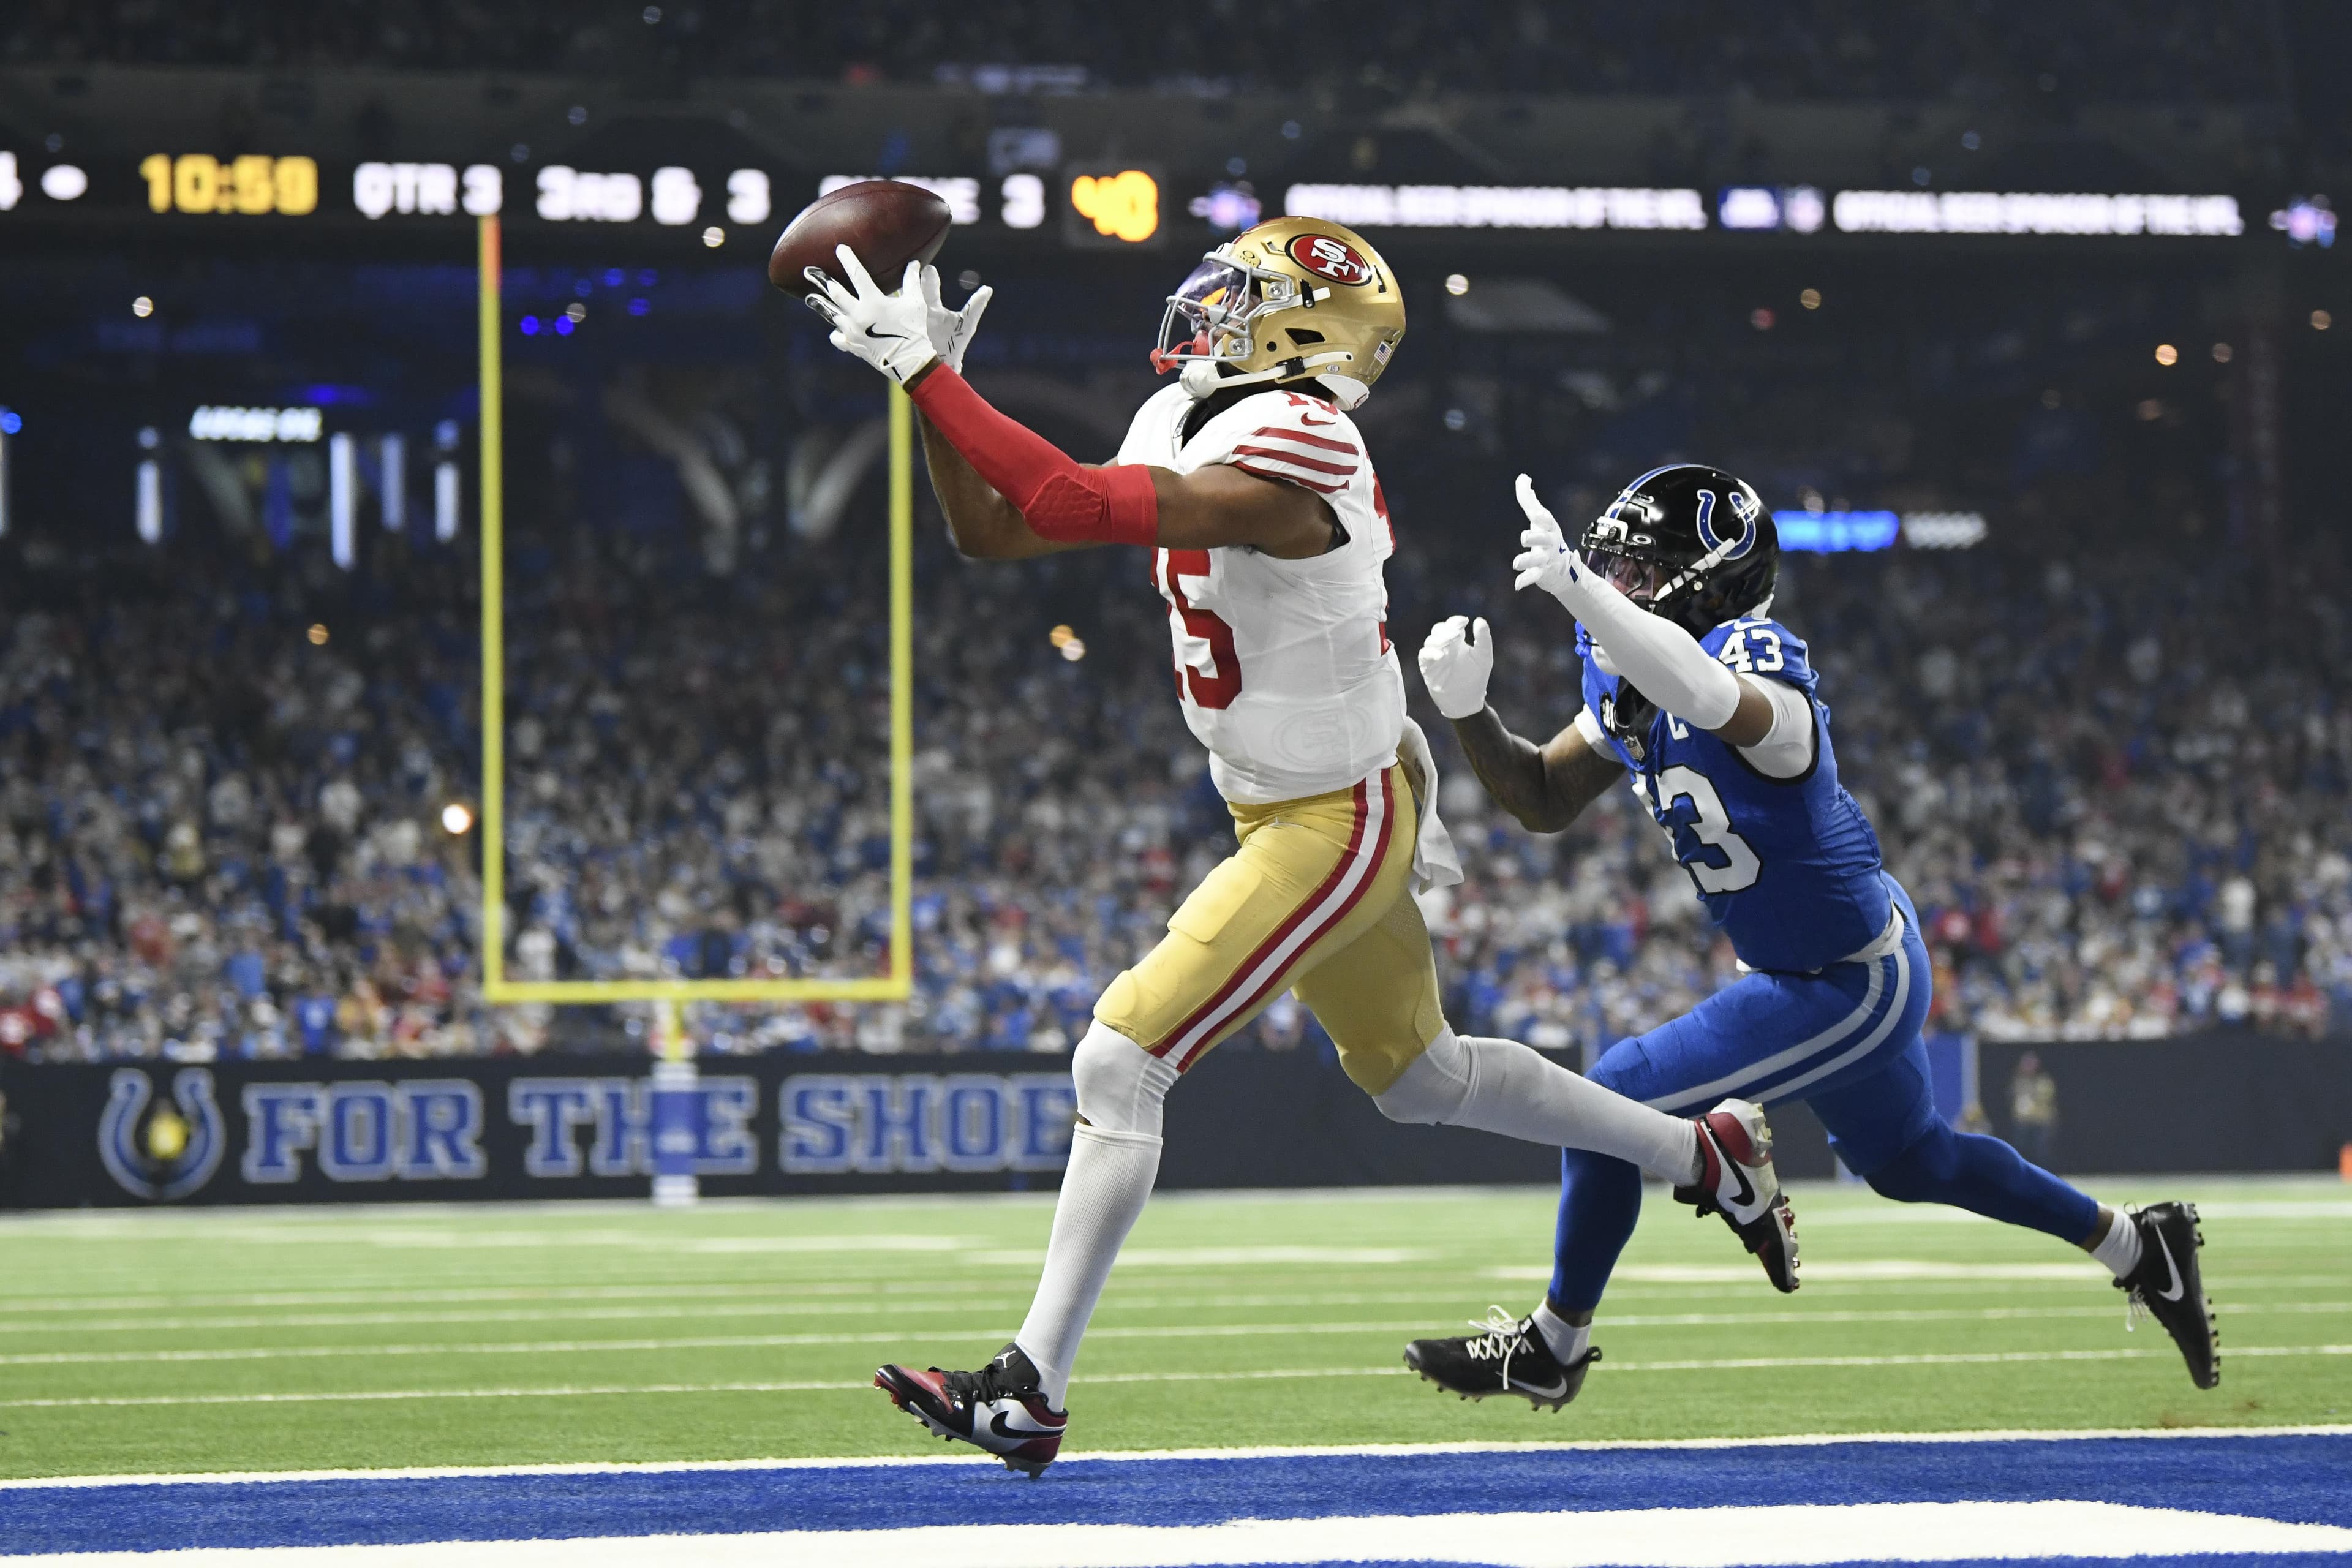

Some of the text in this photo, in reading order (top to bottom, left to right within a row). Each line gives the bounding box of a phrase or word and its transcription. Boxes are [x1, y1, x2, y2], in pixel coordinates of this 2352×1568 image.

[1718, 629, 1784, 673] 43
[241, 1072, 1078, 1184] FOR THE SHOE
